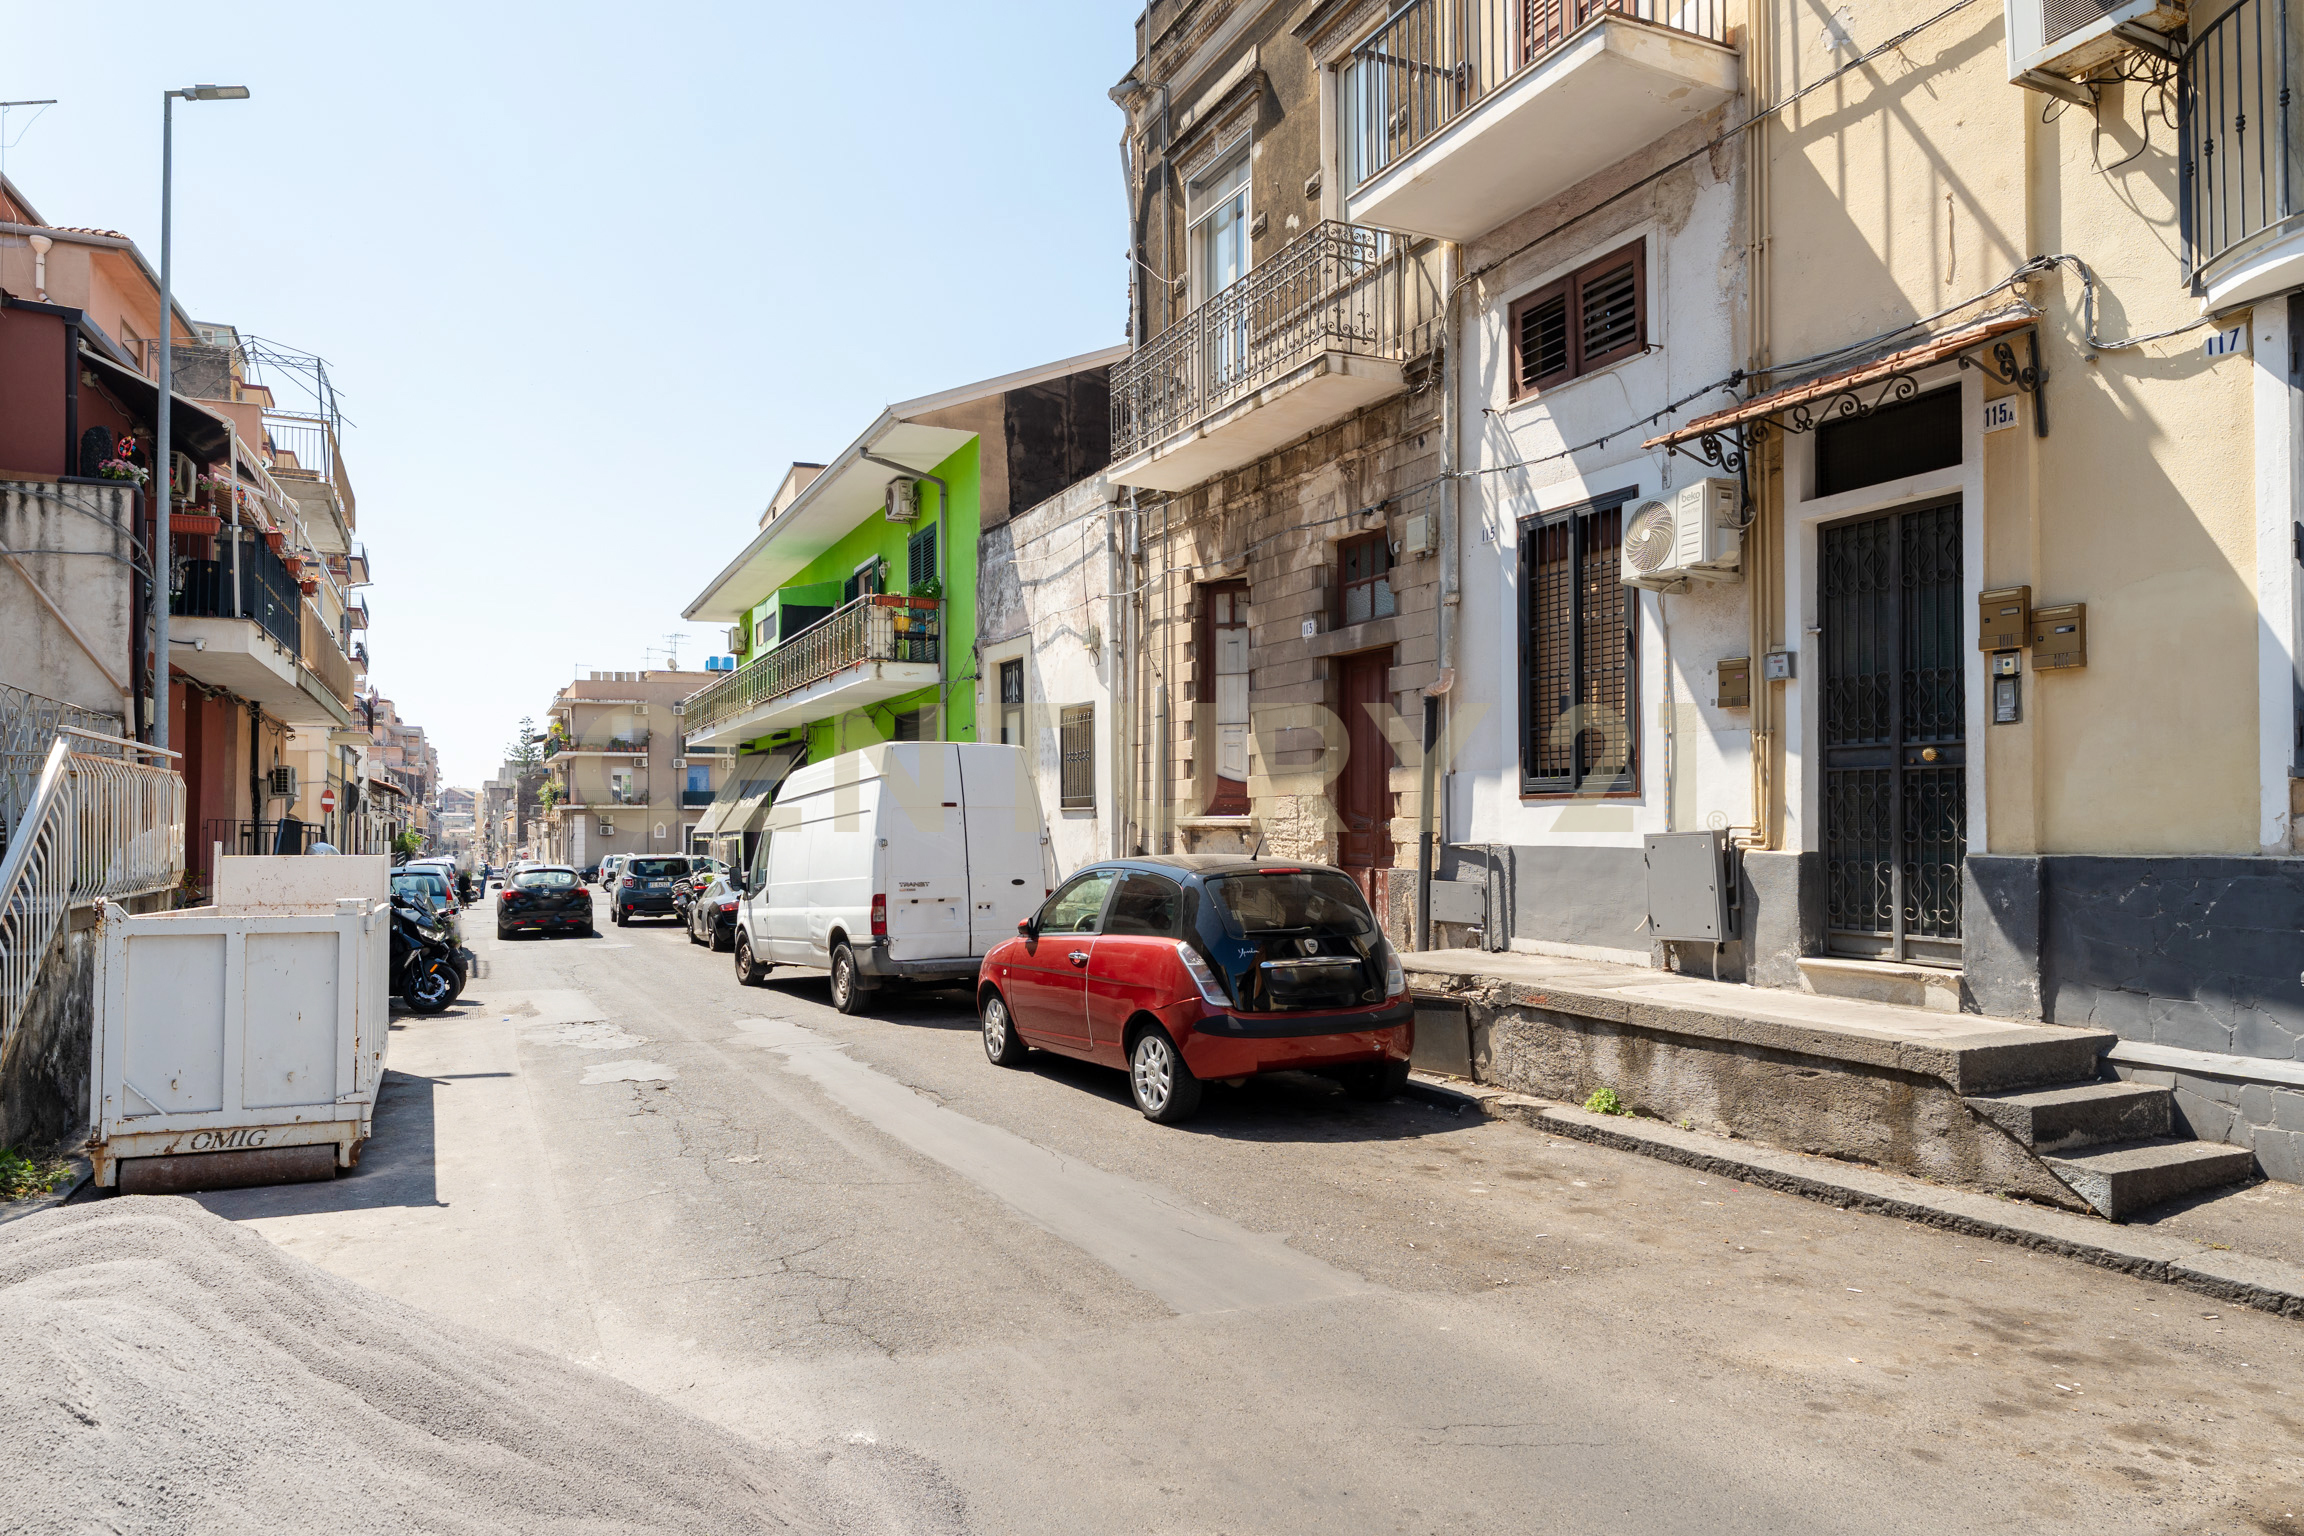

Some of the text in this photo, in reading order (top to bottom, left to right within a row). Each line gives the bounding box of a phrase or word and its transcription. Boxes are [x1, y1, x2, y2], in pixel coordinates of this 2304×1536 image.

[2208, 326, 2240, 355] 117
[1681, 491, 1701, 502] beko
[1482, 526, 1495, 542] 115
[1303, 622, 1313, 636] 113
